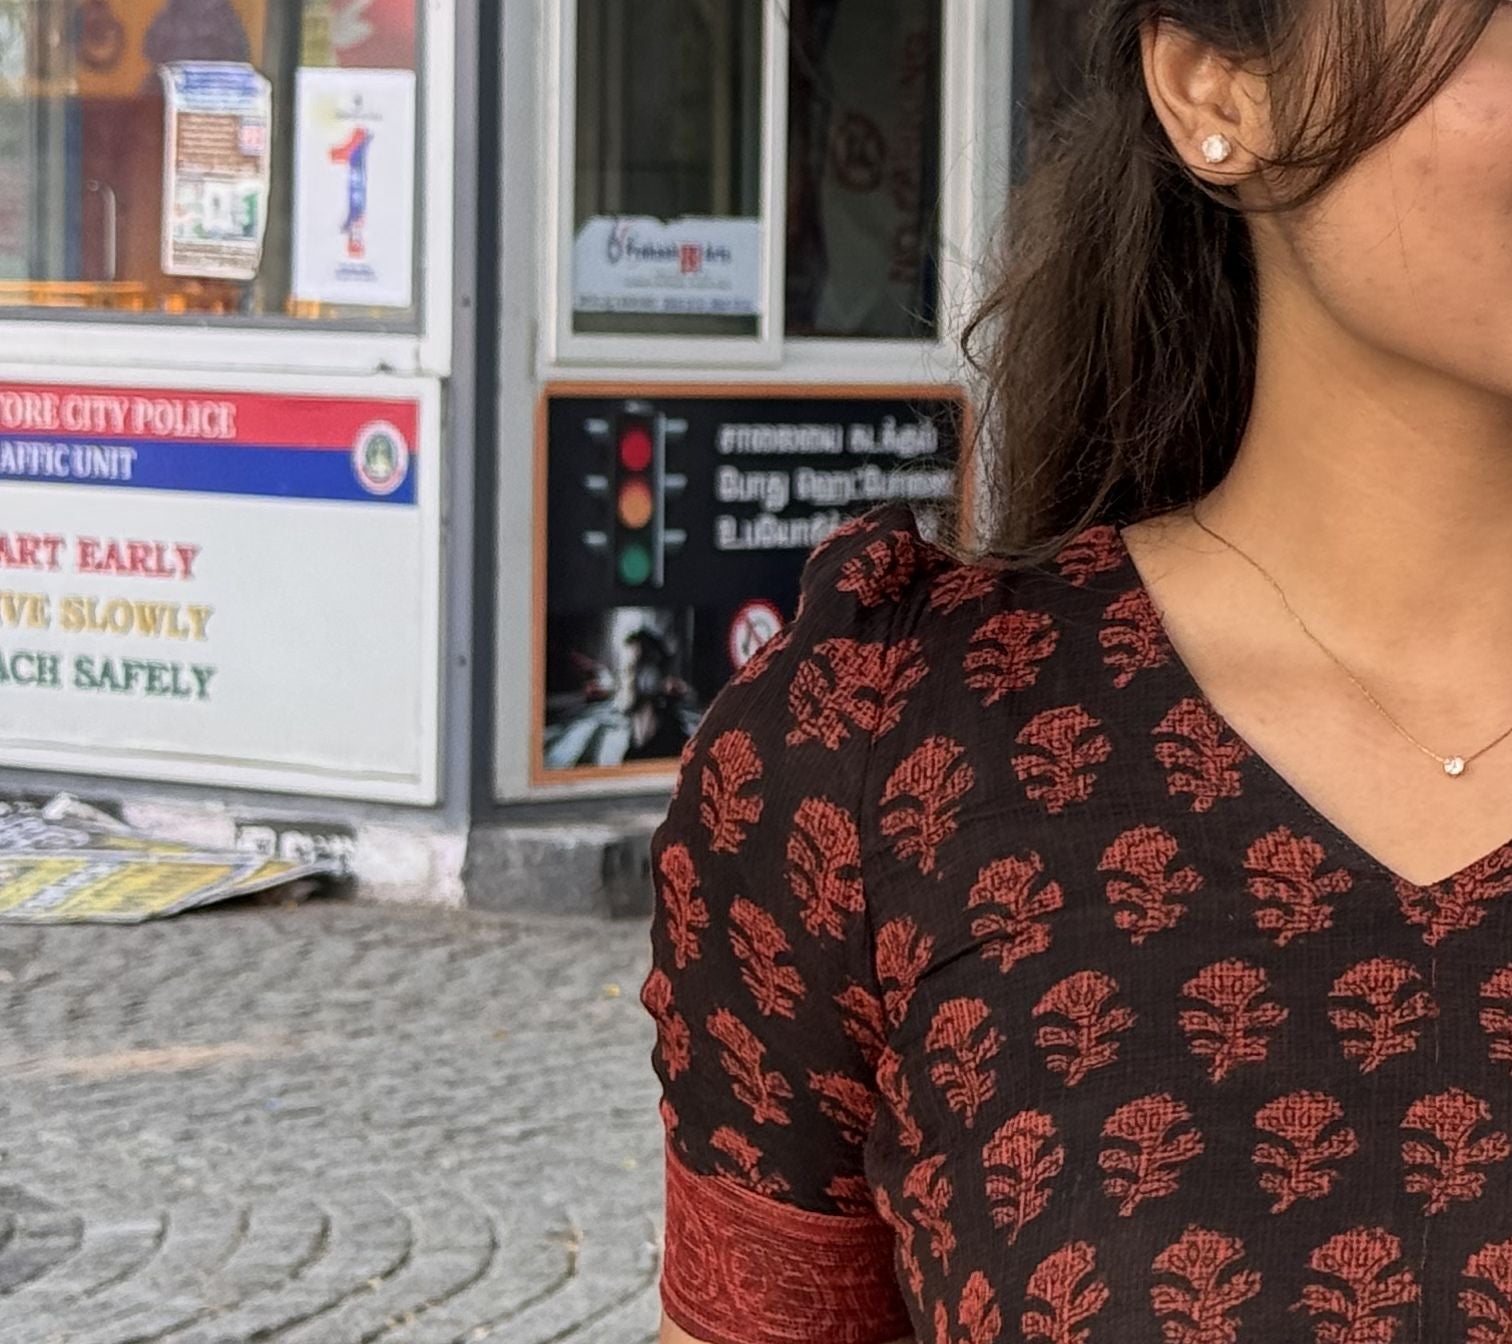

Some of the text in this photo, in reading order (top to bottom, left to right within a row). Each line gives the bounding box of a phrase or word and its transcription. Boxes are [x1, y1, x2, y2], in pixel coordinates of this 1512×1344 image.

[60, 393, 130, 434] CITY
[131, 396, 238, 440] POLICE
[70, 445, 138, 481] UNIT
[75, 534, 202, 582] EARLY
[58, 593, 215, 642] SLOWLY
[72, 654, 219, 703] SAFELY
